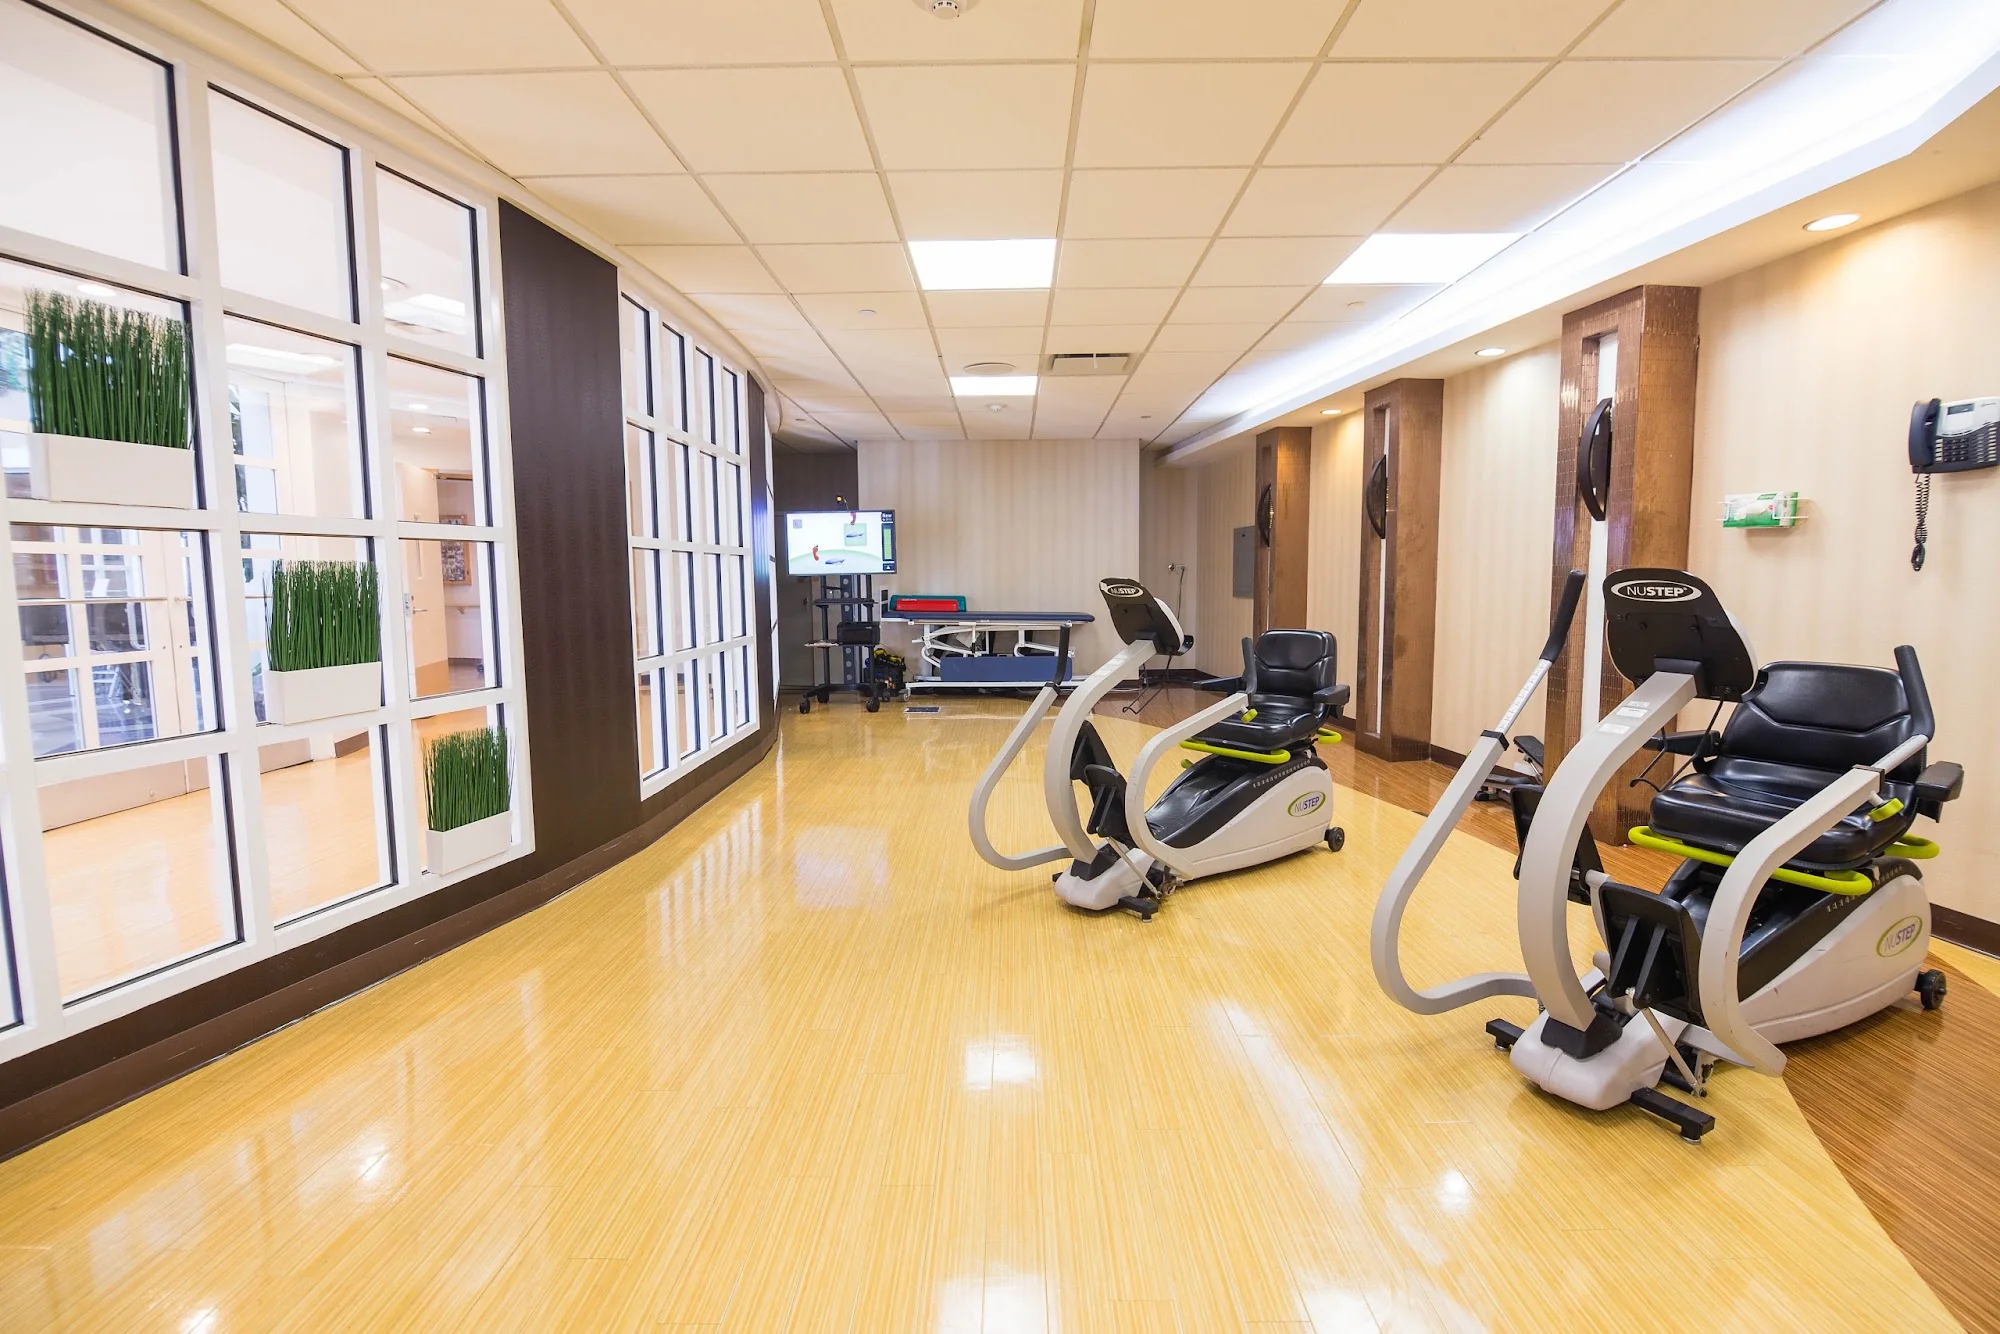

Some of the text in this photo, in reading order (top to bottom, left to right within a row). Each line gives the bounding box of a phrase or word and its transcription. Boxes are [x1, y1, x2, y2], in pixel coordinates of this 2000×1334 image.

[1626, 586, 1685, 597] NUSTEP
[1294, 796, 1319, 813] NUSTEP
[1884, 923, 1916, 951] NUSTEP
